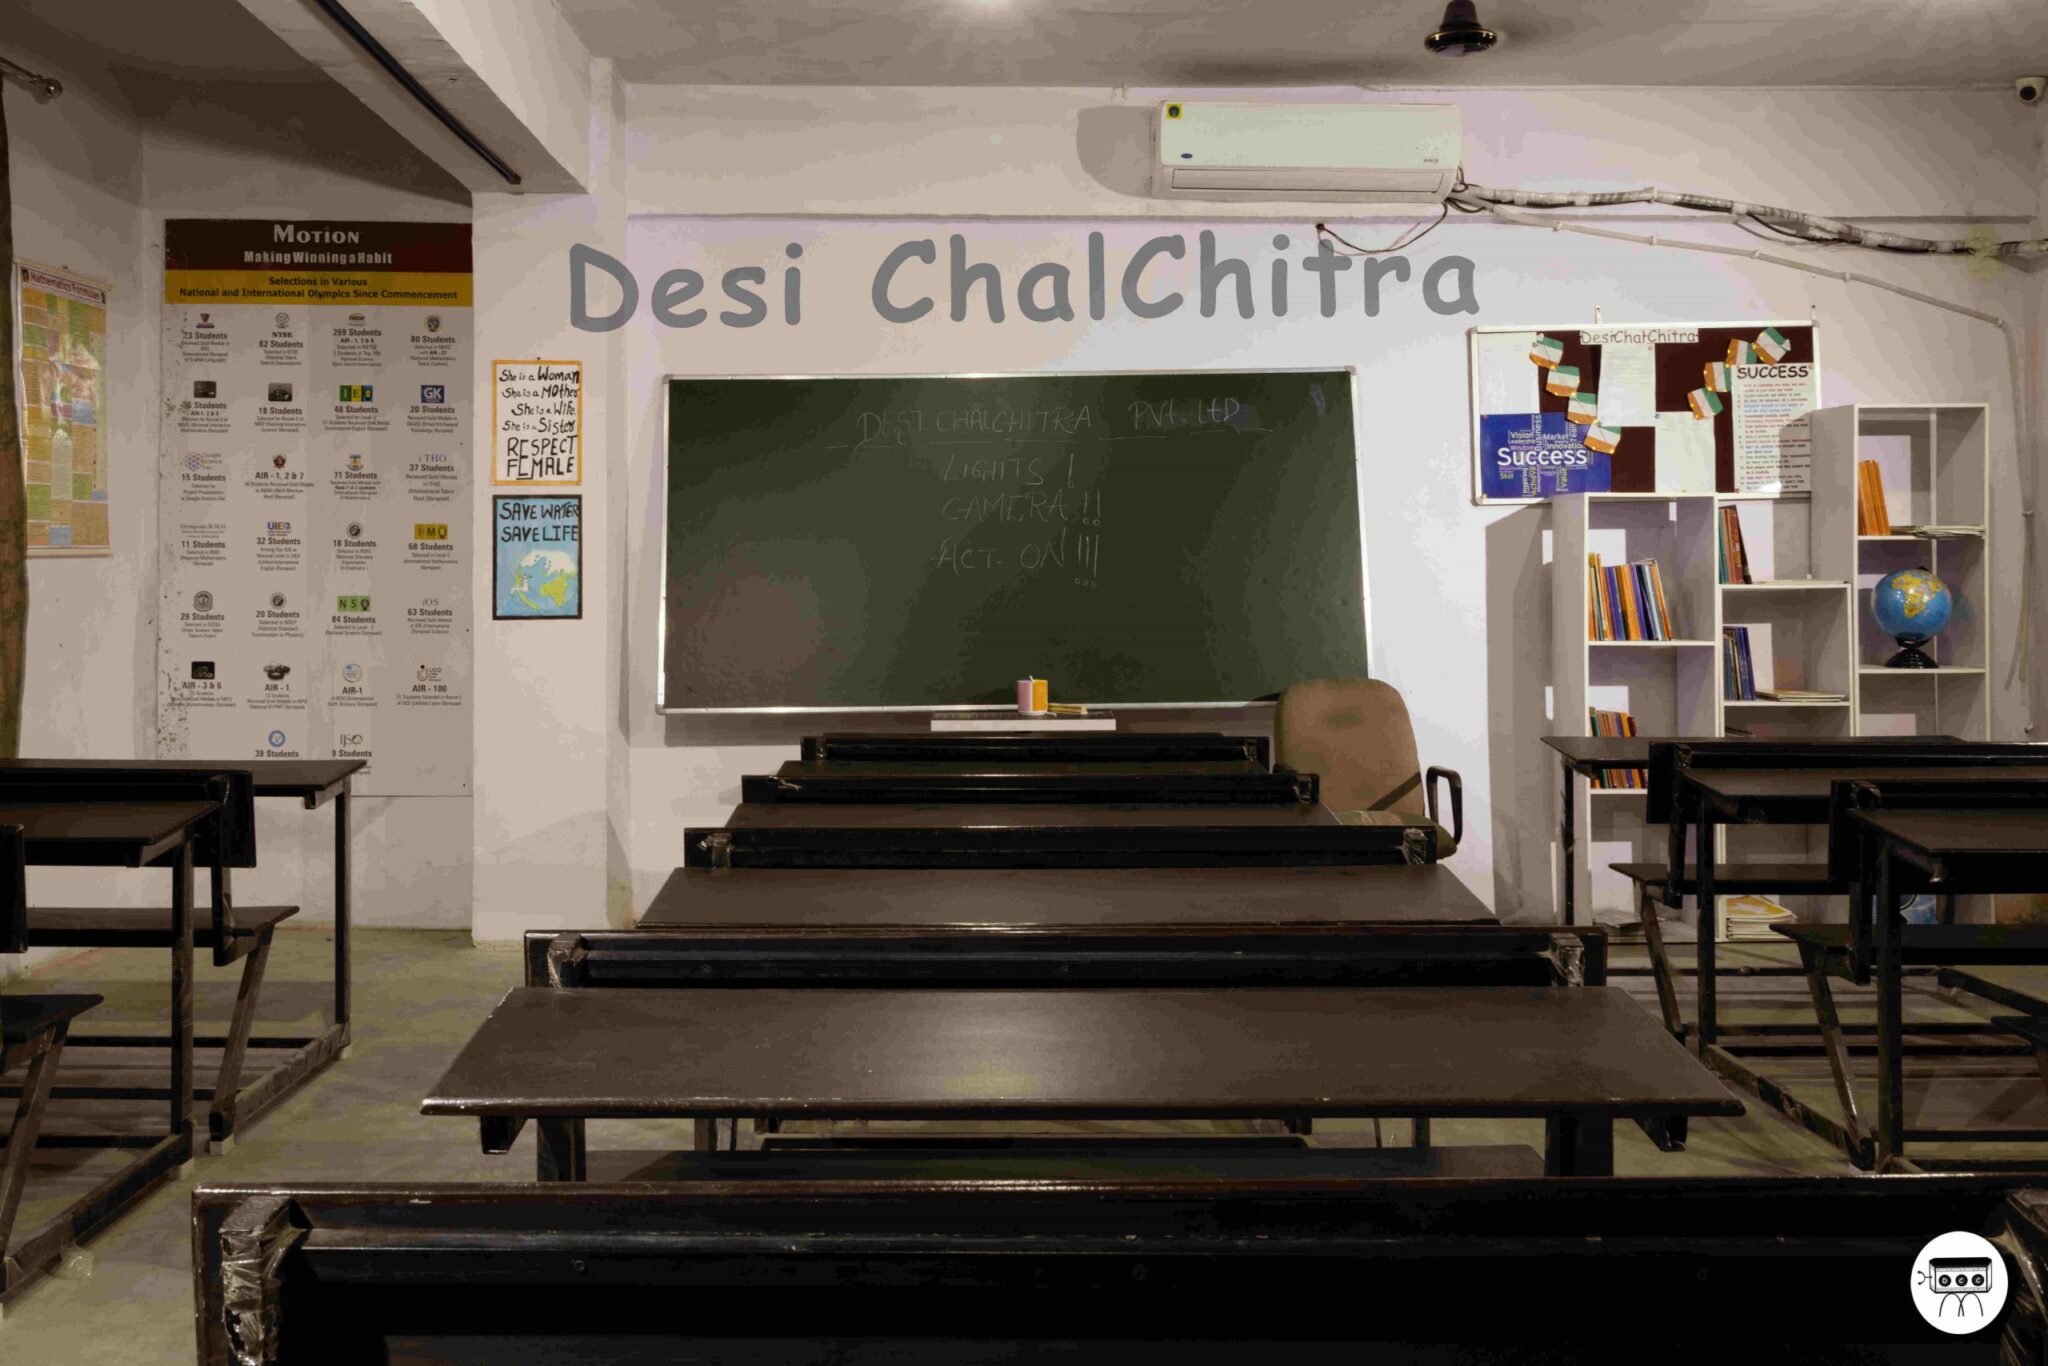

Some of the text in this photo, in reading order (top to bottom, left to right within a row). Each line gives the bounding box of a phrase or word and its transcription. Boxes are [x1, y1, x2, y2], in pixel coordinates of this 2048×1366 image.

[268, 277, 368, 286] Selections in Various
[179, 288, 458, 300] National and International Olympics Since Commencement
[194, 331, 228, 339] Students
[349, 329, 382, 337] Students
[422, 335, 456, 343] Students
[270, 340, 303, 348] Students
[499, 369, 517, 383] She
[519, 372, 526, 381] is
[538, 366, 580, 384] Woman
[1737, 366, 1809, 379] SUCCESS
[424, 387, 442, 398] GK
[502, 387, 521, 399] She
[194, 401, 227, 409] Students
[345, 405, 378, 413] Students
[511, 403, 534, 416] She
[269, 407, 303, 415] Students
[502, 420, 521, 431] She
[537, 417, 576, 435] Sister
[1510, 431, 1534, 439] Vision
[507, 435, 579, 457] RESPECT
[1497, 447, 1587, 466] Success
[421, 464, 454, 472] Students
[507, 456, 575, 480] FEMALE
[192, 473, 226, 482] Students
[345, 472, 377, 480] Students
[941, 489, 1069, 522] CAMERA
[499, 502, 537, 520] SAVE
[501, 526, 579, 543] SAVE LIFE
[192, 540, 226, 549] Students
[268, 537, 301, 546] Students
[344, 539, 377, 548] Students
[420, 542, 453, 551] Students
[192, 612, 224, 621] Students
[267, 610, 300, 619] Students
[419, 608, 452, 617] Students
[343, 615, 376, 624] Students
[266, 749, 299, 758] Students
[338, 749, 372, 757] Students
